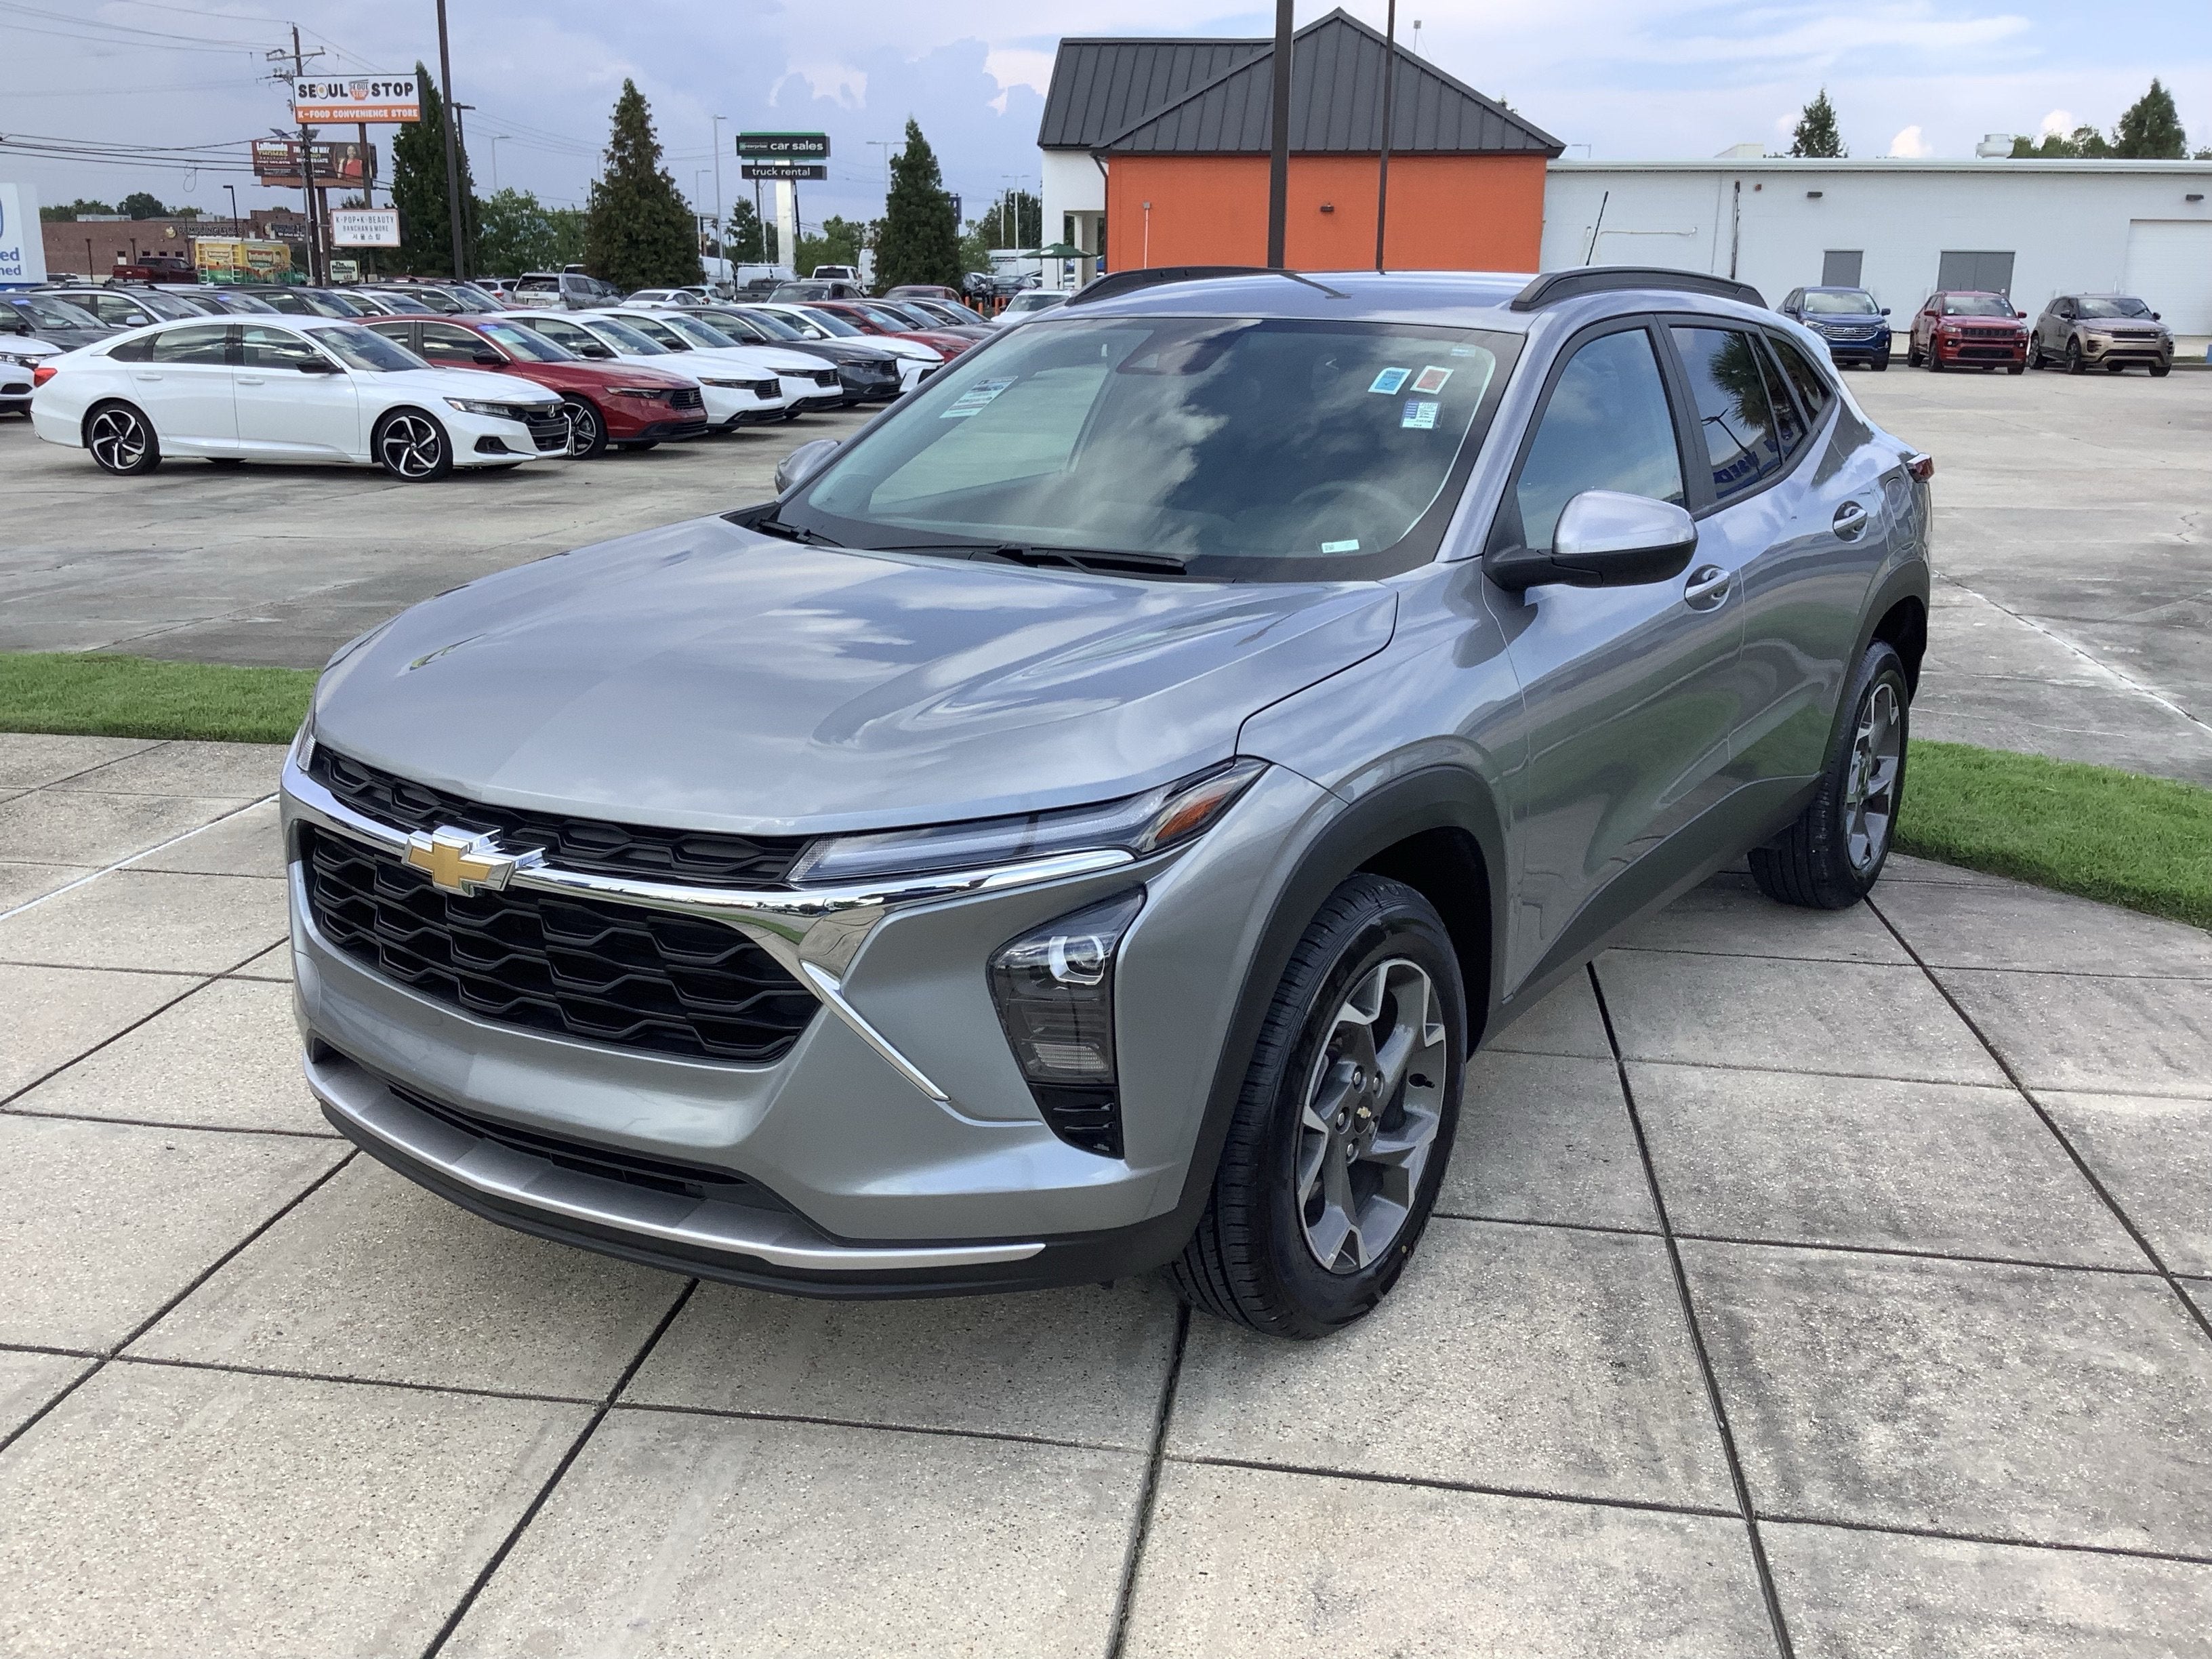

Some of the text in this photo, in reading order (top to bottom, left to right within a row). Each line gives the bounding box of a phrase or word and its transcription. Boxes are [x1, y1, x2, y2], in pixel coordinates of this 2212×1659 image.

[298, 81, 414, 99] SEOUL STOP
[298, 108, 418, 119] K-FOOD CONVENIENCE STORE
[770, 142, 790, 150] car
[792, 140, 823, 150] sales
[751, 166, 811, 176] truck rental
